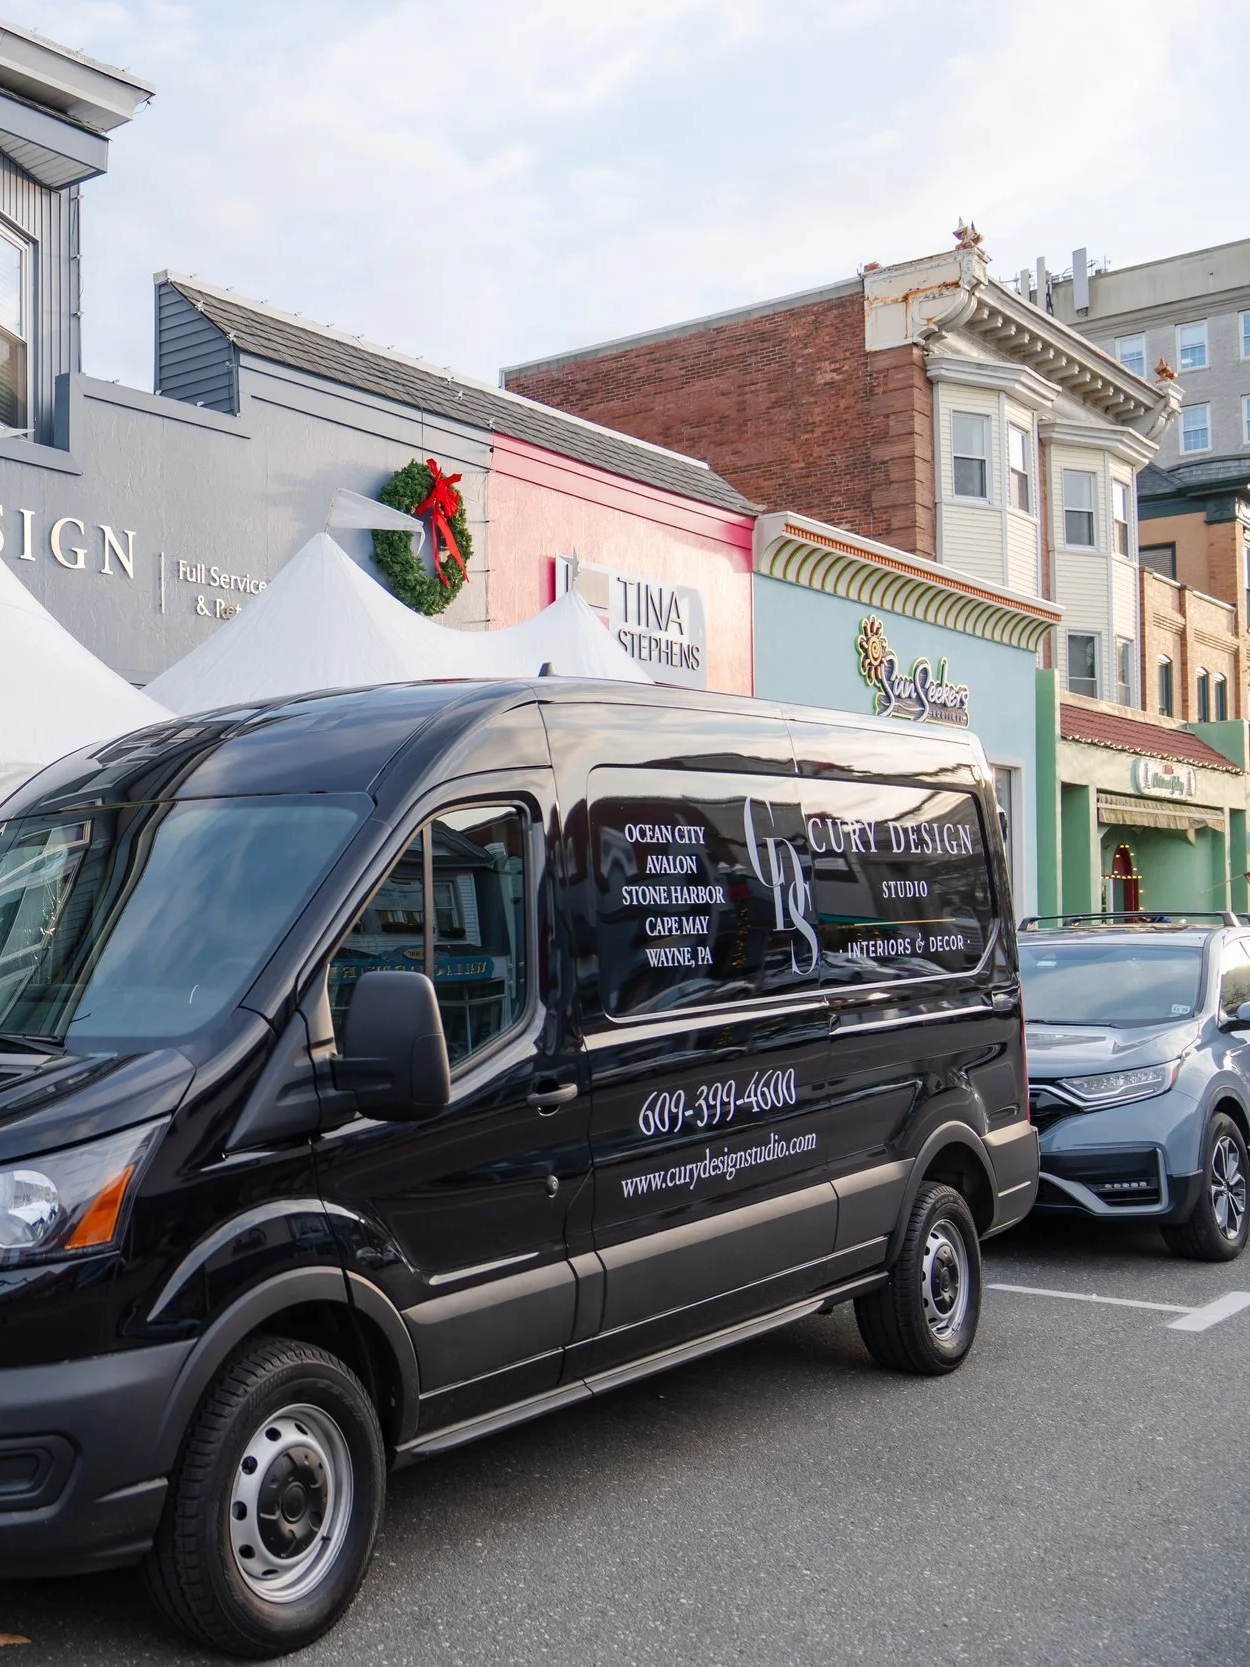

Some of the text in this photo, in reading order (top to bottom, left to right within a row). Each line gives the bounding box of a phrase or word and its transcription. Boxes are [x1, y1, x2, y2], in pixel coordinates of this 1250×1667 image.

[178, 559, 268, 594] Full Service
[196, 595, 211, 616] &
[617, 576, 700, 670] TINA STEPHENS
[624, 824, 705, 844] OCEAN CITY
[807, 817, 973, 855] CURY DESIGN
[646, 855, 697, 874] AVALON
[622, 886, 725, 905] STONE HARBOR
[882, 881, 928, 898] STUDIO
[645, 916, 709, 936] CAPE MAY
[848, 933, 964, 958] INTERIORS & DECOR
[646, 947, 713, 967] WAYNE, PA
[638, 1068, 797, 1136] 609-399-4600
[621, 1132, 816, 1198] www.curydesignstudio.com
